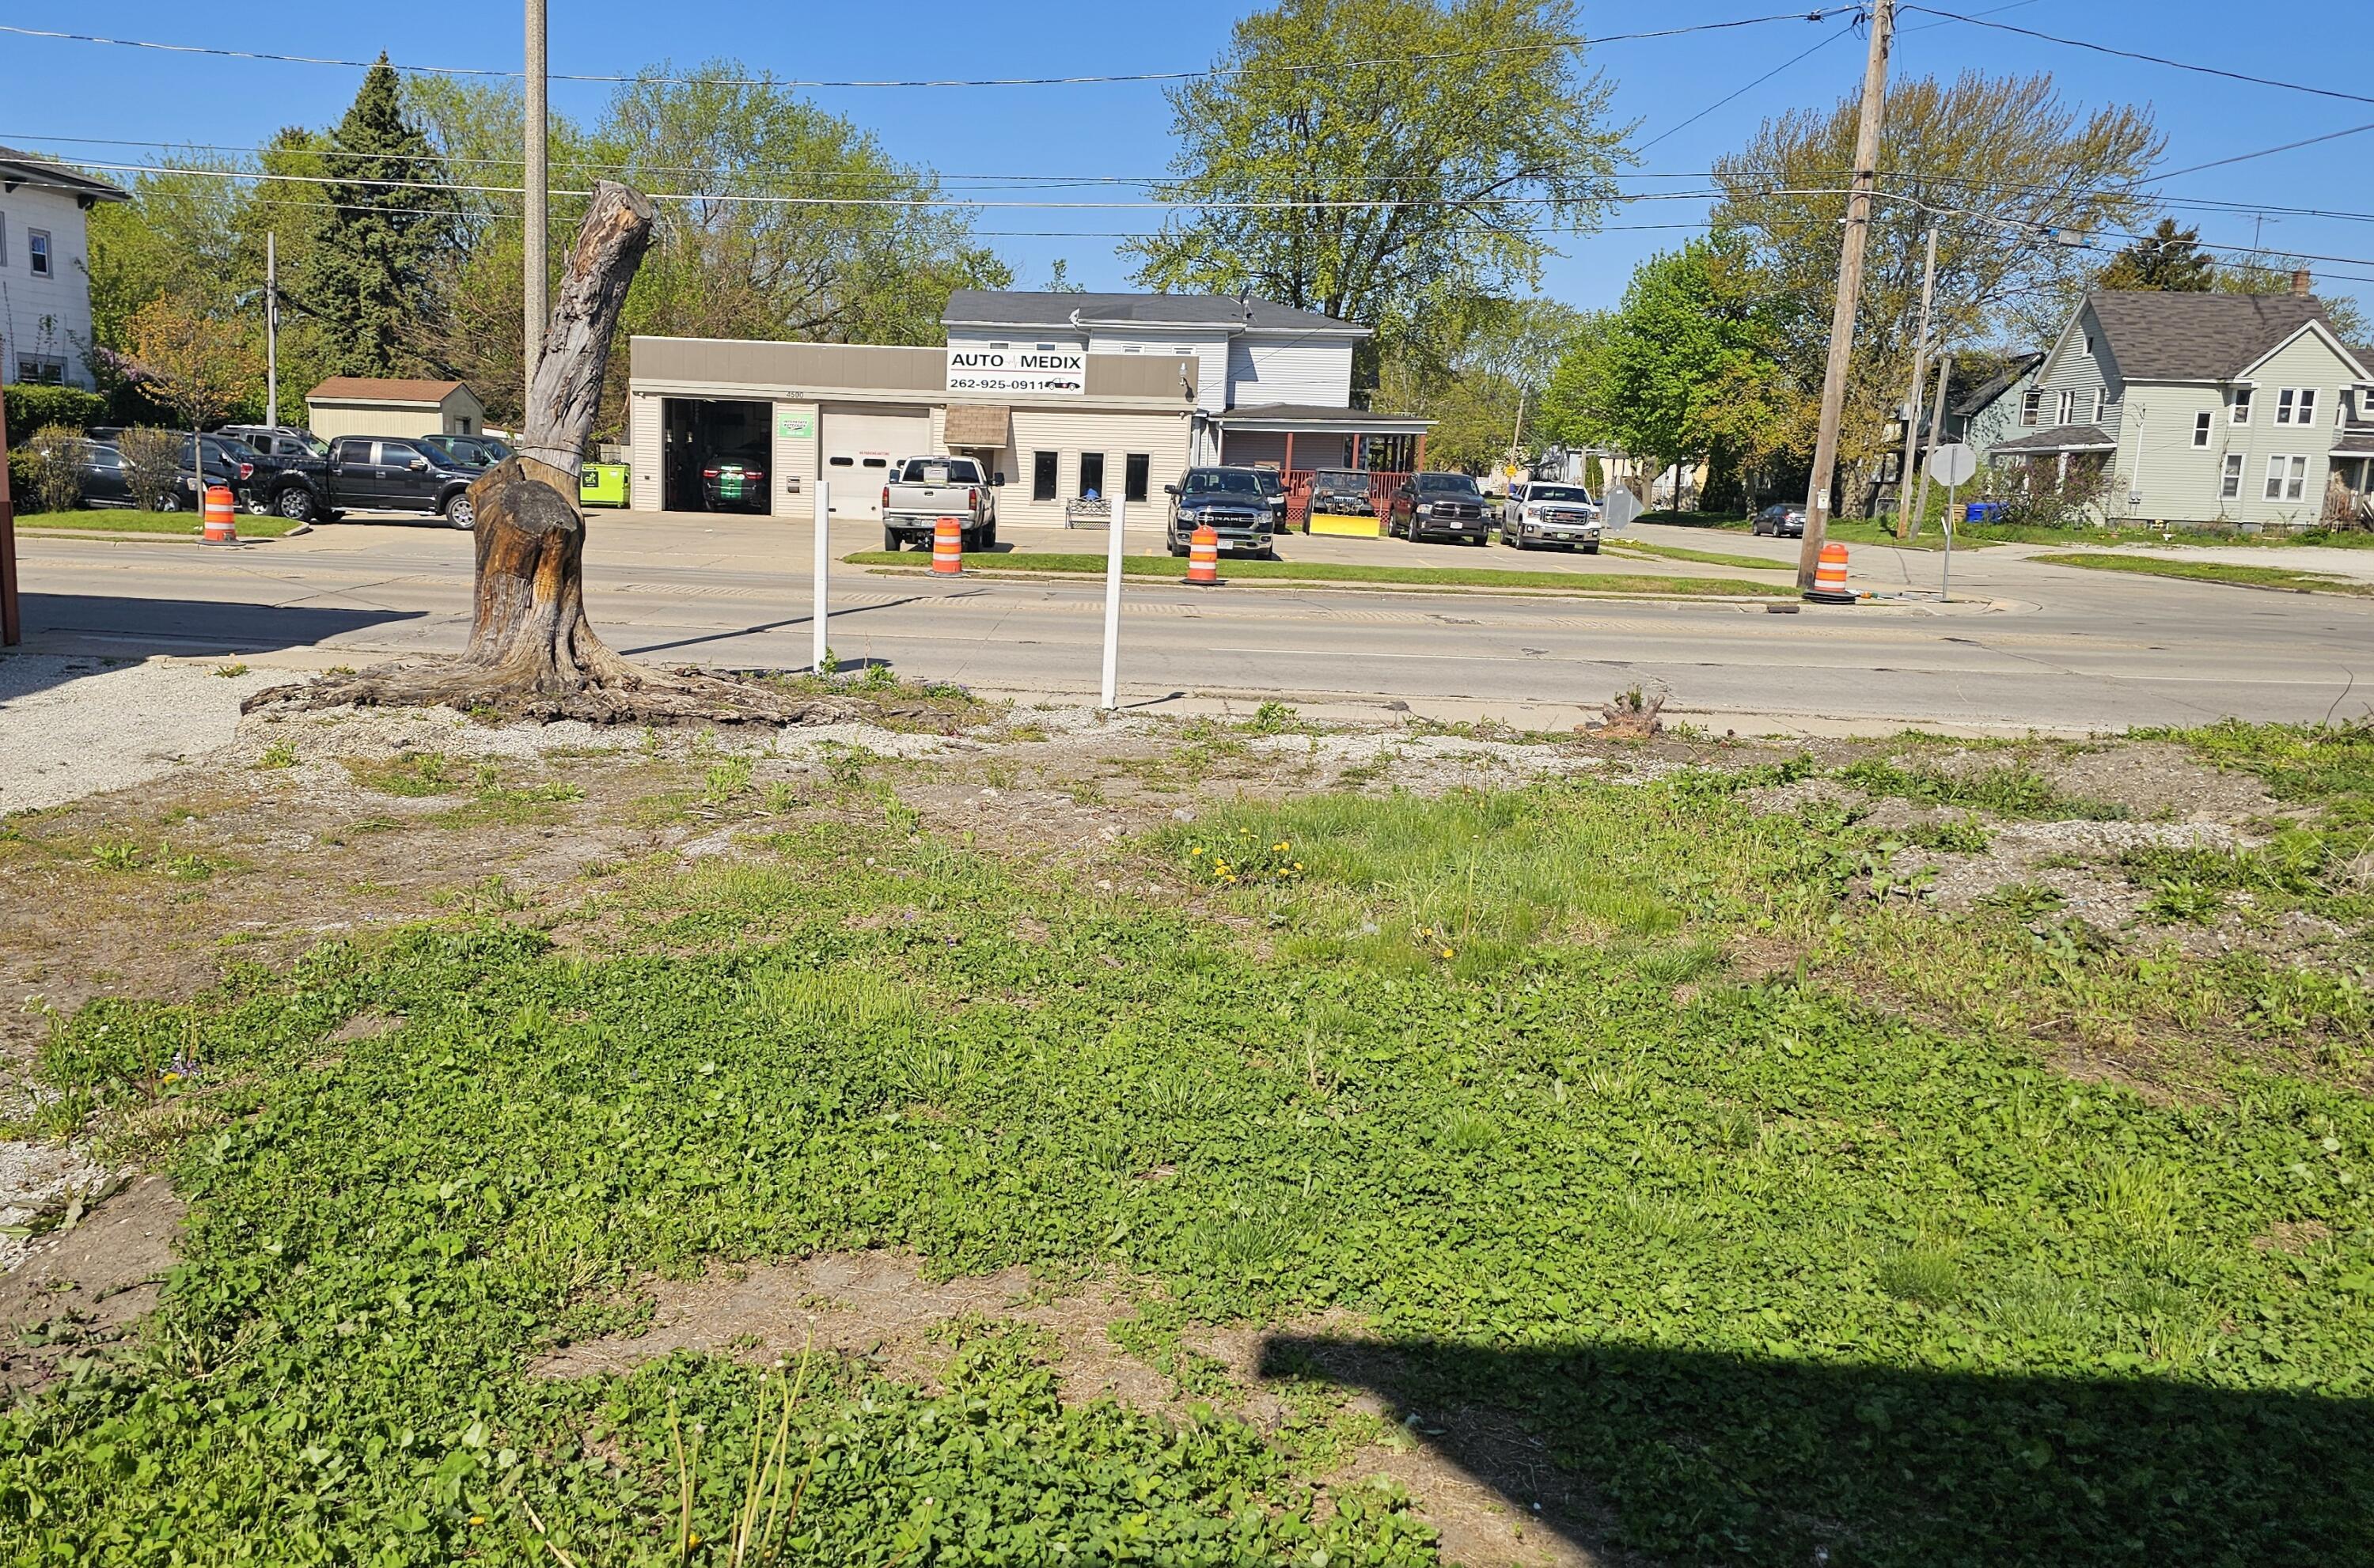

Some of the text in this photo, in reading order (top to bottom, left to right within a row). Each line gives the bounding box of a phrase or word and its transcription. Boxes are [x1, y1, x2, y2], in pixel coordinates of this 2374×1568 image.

[951, 354, 1082, 369] AUTO MEDIX
[950, 379, 1045, 390] 262-925-0911
